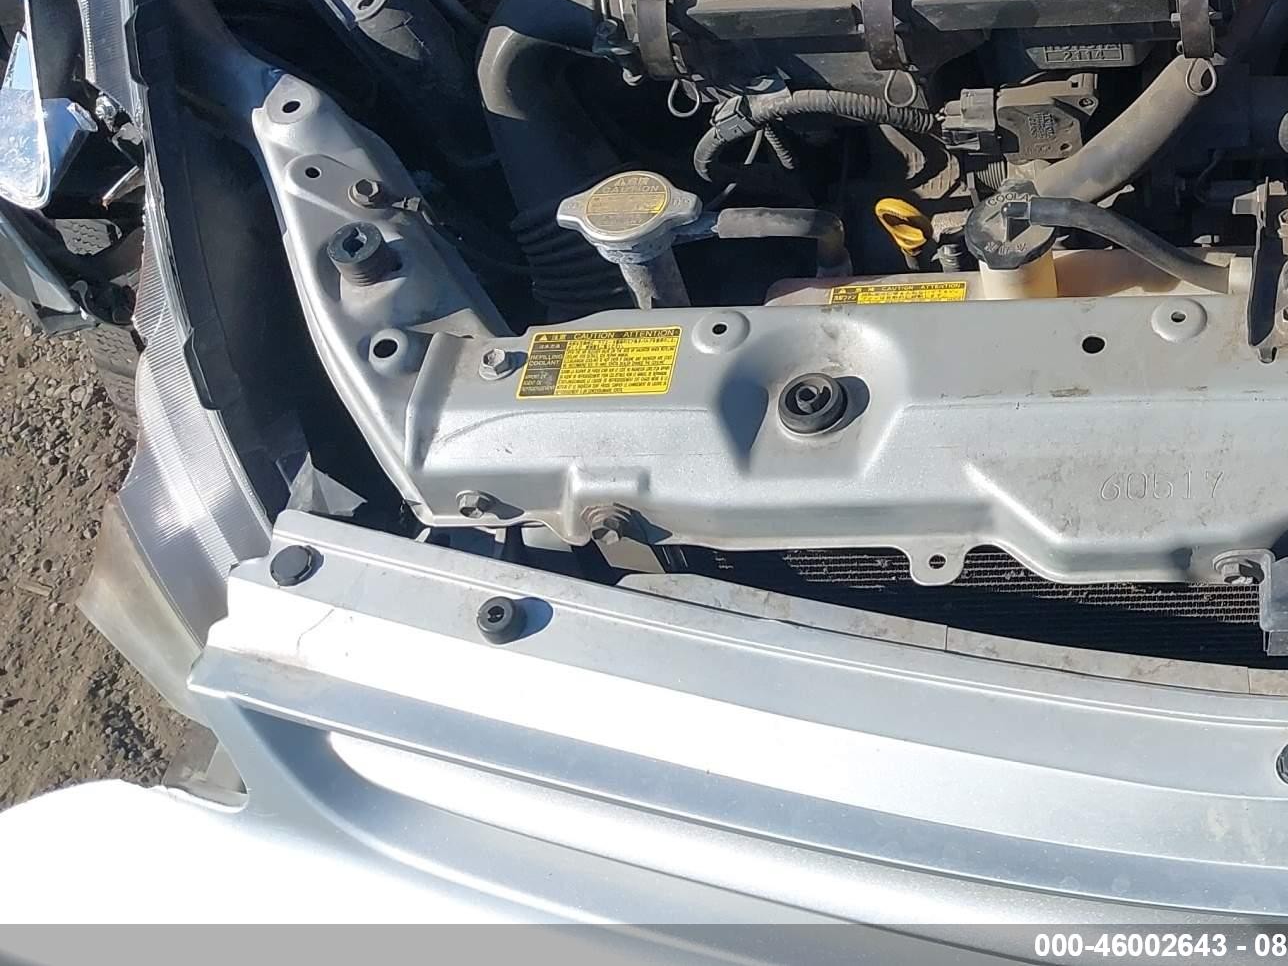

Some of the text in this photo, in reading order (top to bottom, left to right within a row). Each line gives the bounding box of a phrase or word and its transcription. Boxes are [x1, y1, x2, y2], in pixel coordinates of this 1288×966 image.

[573, 332, 615, 340] CAUTION
[623, 329, 675, 338] ATTENTION
[1100, 470, 1224, 501] 60517
